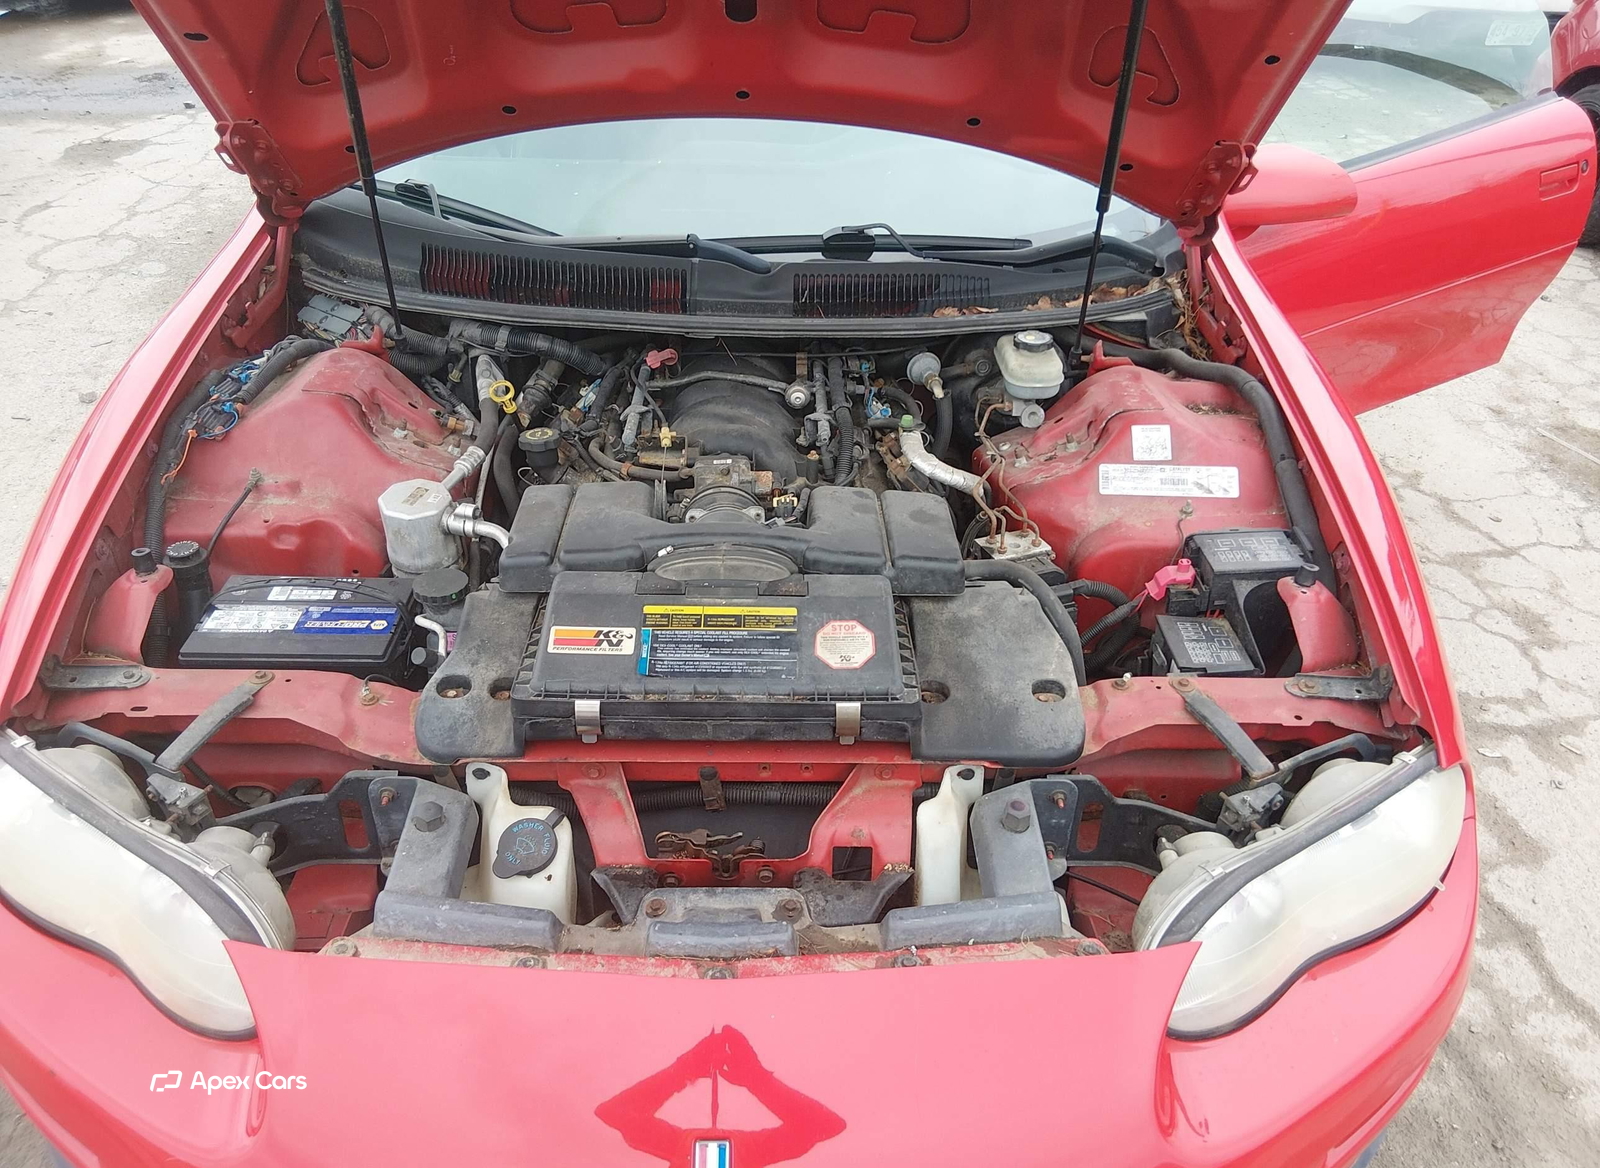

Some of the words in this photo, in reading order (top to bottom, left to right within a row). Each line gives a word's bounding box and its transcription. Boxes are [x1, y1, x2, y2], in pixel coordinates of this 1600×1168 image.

[831, 624, 857, 632] STOP
[593, 630, 633, 647] K&N
[512, 822, 544, 833] WASHER
[541, 832, 551, 855] FLUID
[505, 851, 521, 865] ONLY
